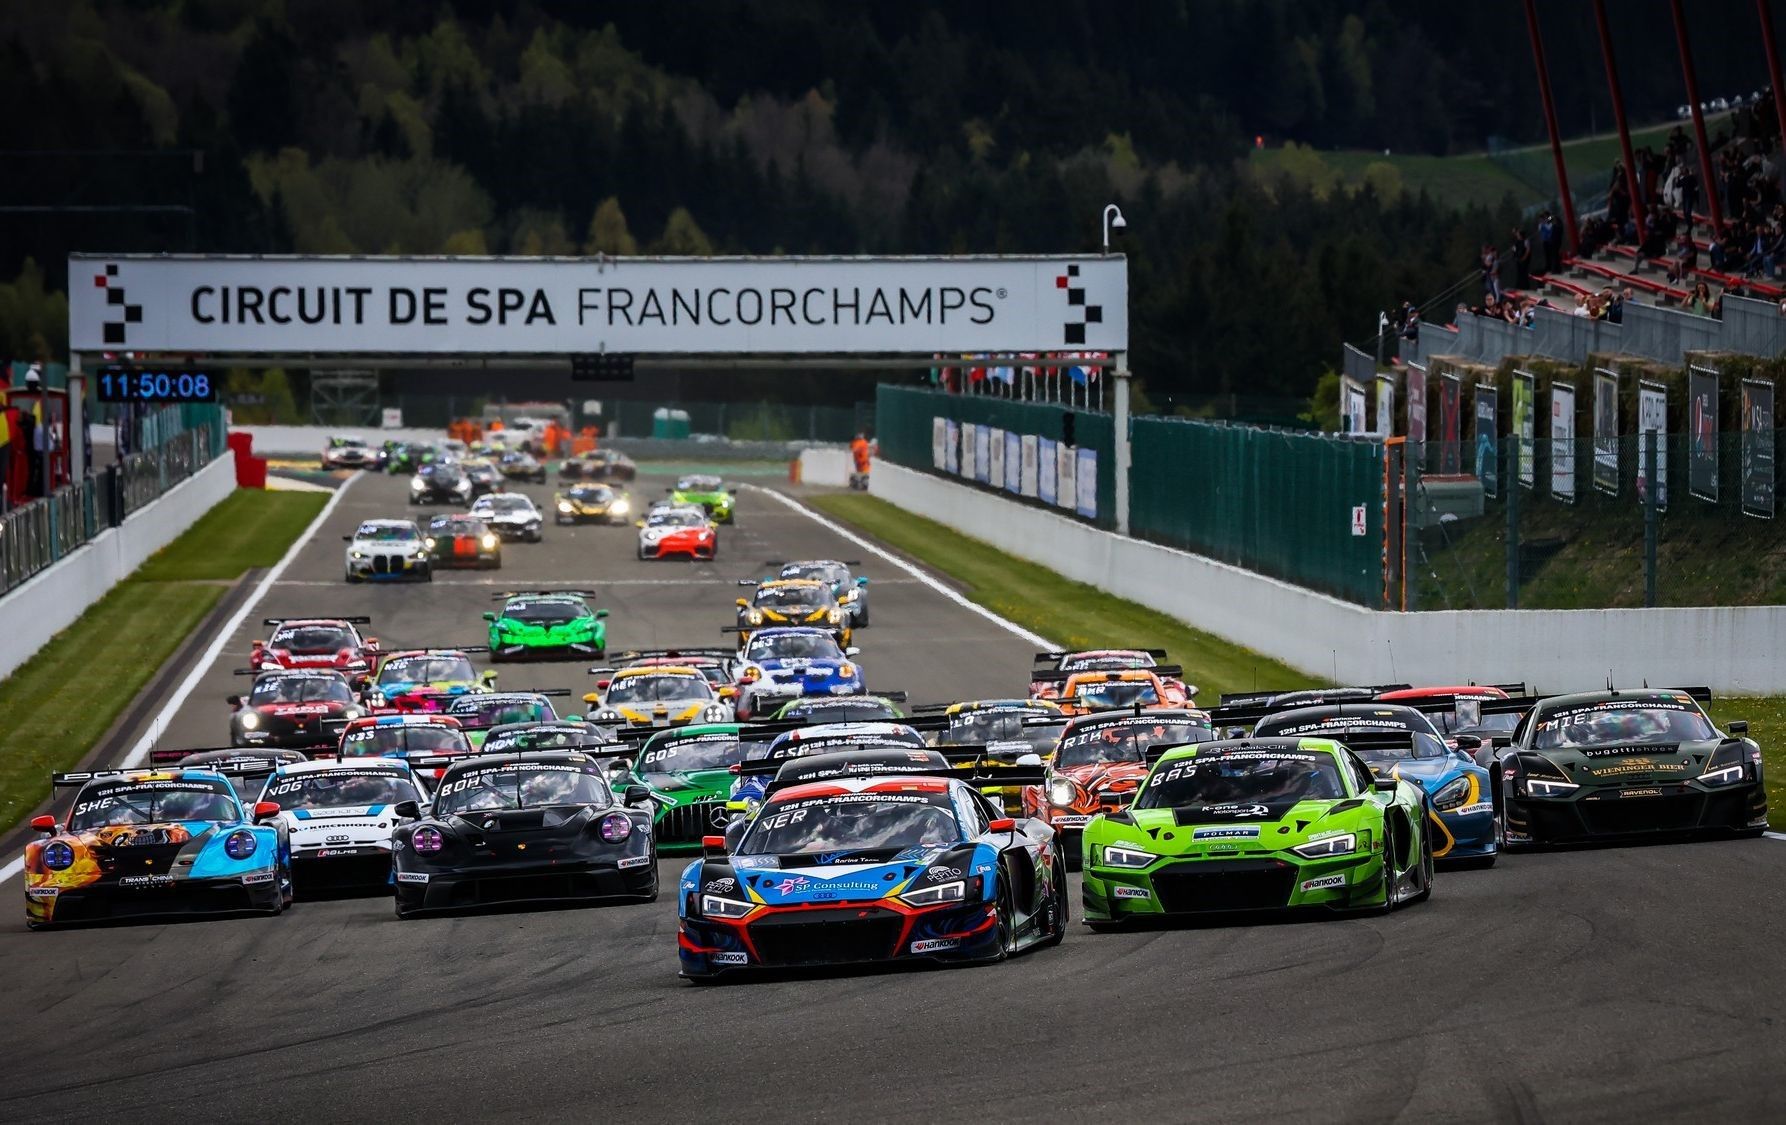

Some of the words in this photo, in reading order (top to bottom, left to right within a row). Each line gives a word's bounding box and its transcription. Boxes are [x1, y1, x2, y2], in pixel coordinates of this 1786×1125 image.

[191, 286, 373, 325] CIRCUIT
[389, 287, 448, 326] DE
[466, 287, 557, 326] SPA
[101, 373, 210, 398] 11:50:08
[1571, 702, 1686, 714] SPA-FRANCORCHAMPS
[1079, 725, 1097, 733] 12H
[1098, 719, 1198, 730] SPA-FRANCORCHAMPS
[1279, 727, 1298, 736] 12H
[1298, 720, 1407, 732] SPA-FRANCORCHAMPS
[1545, 713, 1586, 732] MIE
[1063, 731, 1102, 750] RIK
[644, 746, 678, 764] GOS
[1173, 760, 1193, 769] 12H
[1194, 753, 1317, 765] SPA-FRANCORCHAMPS
[296, 770, 399, 781] SPA-FRANCORCHAMPS
[480, 765, 582, 776] SPA-FRANCORCHAMPS
[1150, 765, 1198, 788] BAS
[1592, 764, 1656, 777] WIENINGER
[97, 788, 113, 796] 12H
[115, 783, 214, 795] SPA-FRANCORCHAMPS
[269, 781, 303, 797] VOG
[440, 776, 481, 797] BOH
[75, 798, 114, 816] SHE
[779, 802, 800, 813] 12H
[801, 795, 929, 809] SPA-FRANCORCHAMPS
[762, 809, 808, 831] VER
[927, 867, 962, 882] PEPITO
[704, 879, 734, 893] PEPITO
[795, 884, 811, 892] SP
[813, 881, 879, 891] Consulting
